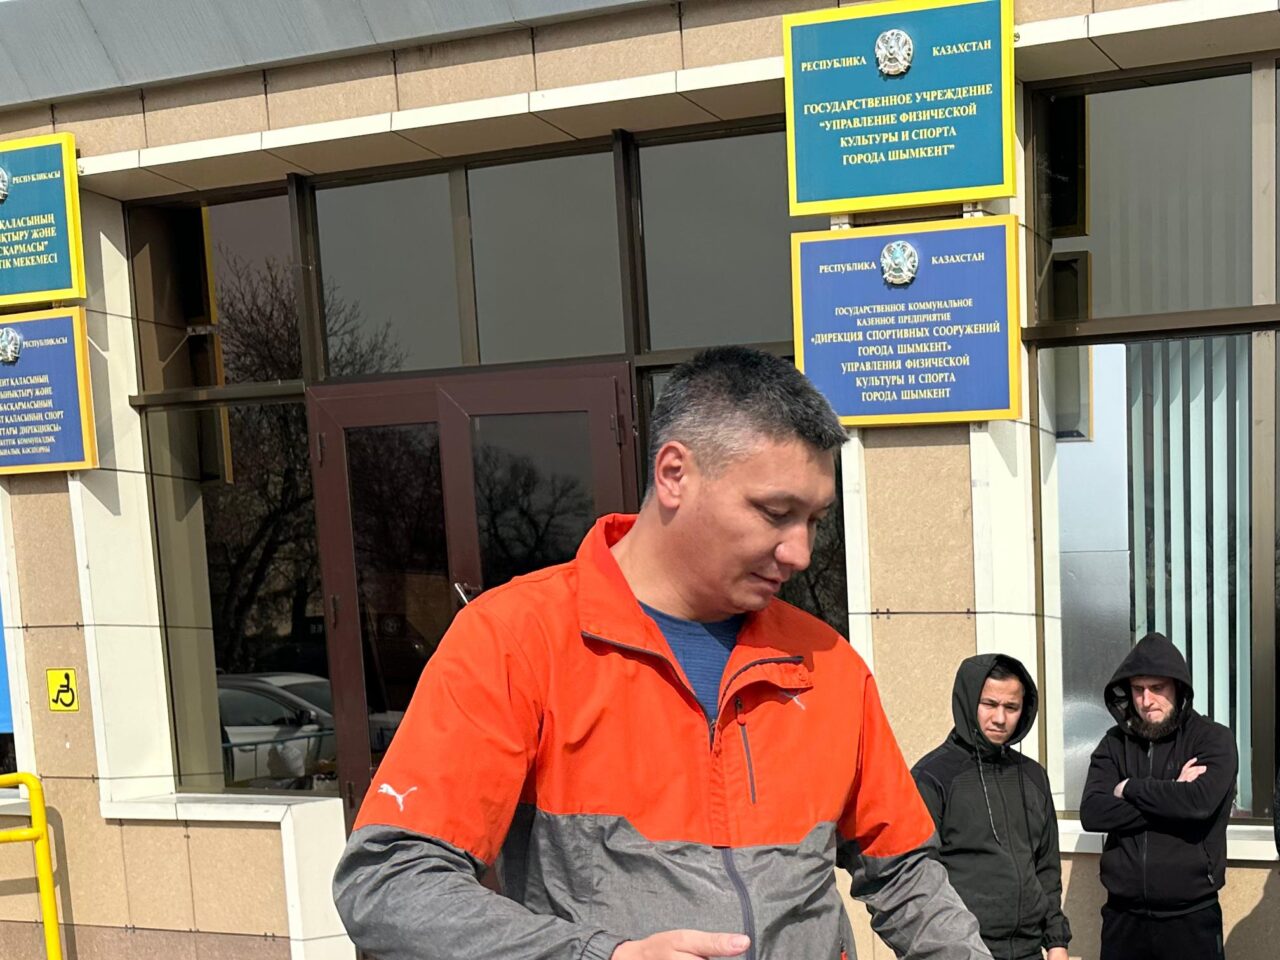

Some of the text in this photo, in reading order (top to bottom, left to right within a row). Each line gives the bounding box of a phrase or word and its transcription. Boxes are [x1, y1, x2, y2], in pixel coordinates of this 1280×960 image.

[801, 39, 992, 72] РЕСПУБЛИКА КАЗАХСТАН
[803, 83, 993, 115] ГОСУДАРСТВЕННОЕ УЧРЕЖДЕНИЕ
[899, 103, 977, 123] ФИЗИЧЕСКОЙ
[840, 126, 957, 148] КУЛЬТУРЫ И СПОРТА
[842, 152, 885, 166] ГОРОДА
[31, 227, 57, 239] ЖӘНЕ
[13, 253, 58, 267] МЕКЕМЕСІ
[819, 252, 985, 274] РЕСПУБЛИКА КАЗАХСТАН
[835, 298, 974, 316] ГОСУДАРСТВЕННОЕ КОММУНАЛЬНОЕ
[856, 312, 952, 327] КАЗЕННОЕ ПРЕДПРИЯТИЕ
[866, 326, 930, 342] СПОРТИВНЫХ
[932, 320, 1001, 337] СООРУЖЕНИЙ
[858, 345, 894, 357] ГОРОДА
[841, 354, 970, 375] УПРАВЛЕНИЯ ФИЗИЧЕСКОЙ
[855, 372, 956, 389] КУЛЬТУРЫ И СПОРТА
[861, 387, 951, 403] ГОРОДА ШЫМКЕНТ
[44, 410, 64, 420] СПОРТ
